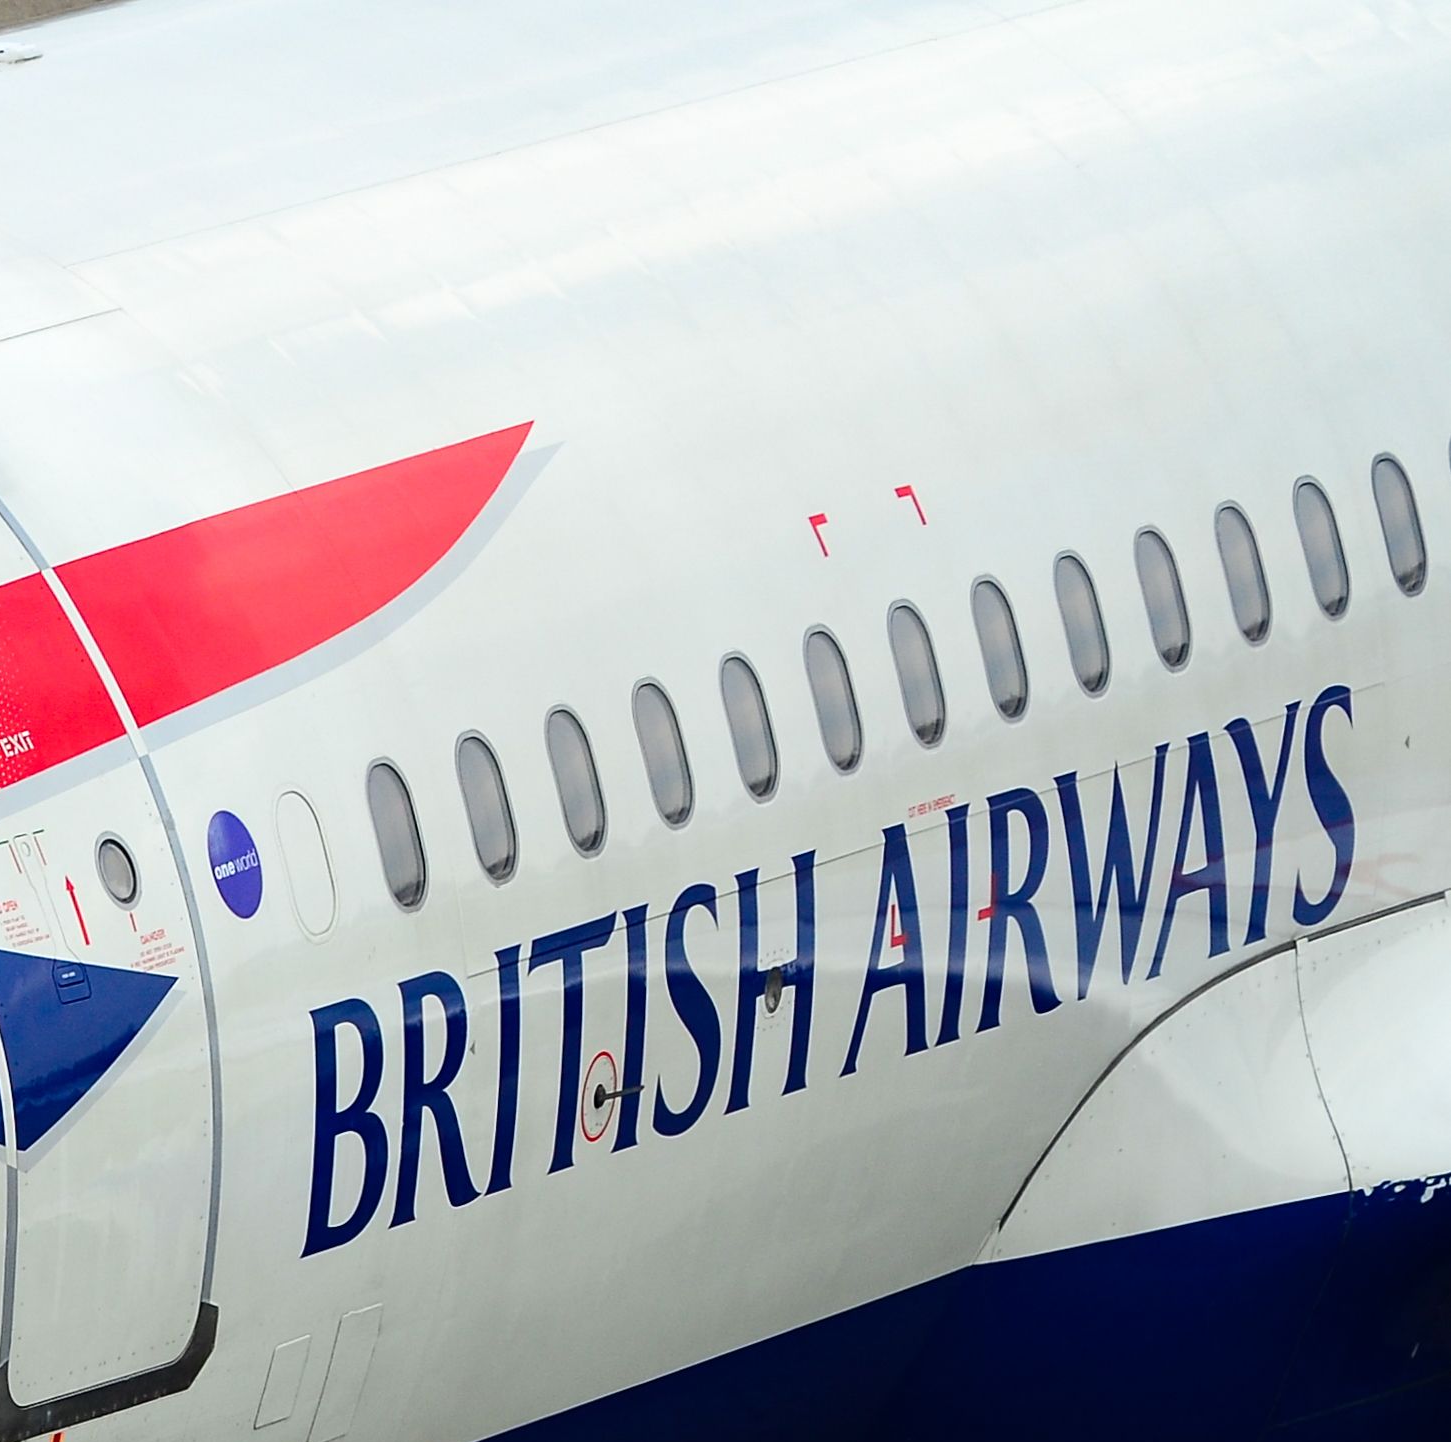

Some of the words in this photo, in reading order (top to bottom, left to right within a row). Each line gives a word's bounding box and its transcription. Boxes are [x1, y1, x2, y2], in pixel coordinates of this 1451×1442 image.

[0, 730, 34, 758] EXIT
[299, 850, 816, 1259] BRITISH
[838, 685, 1354, 1079] AIRWAYS
